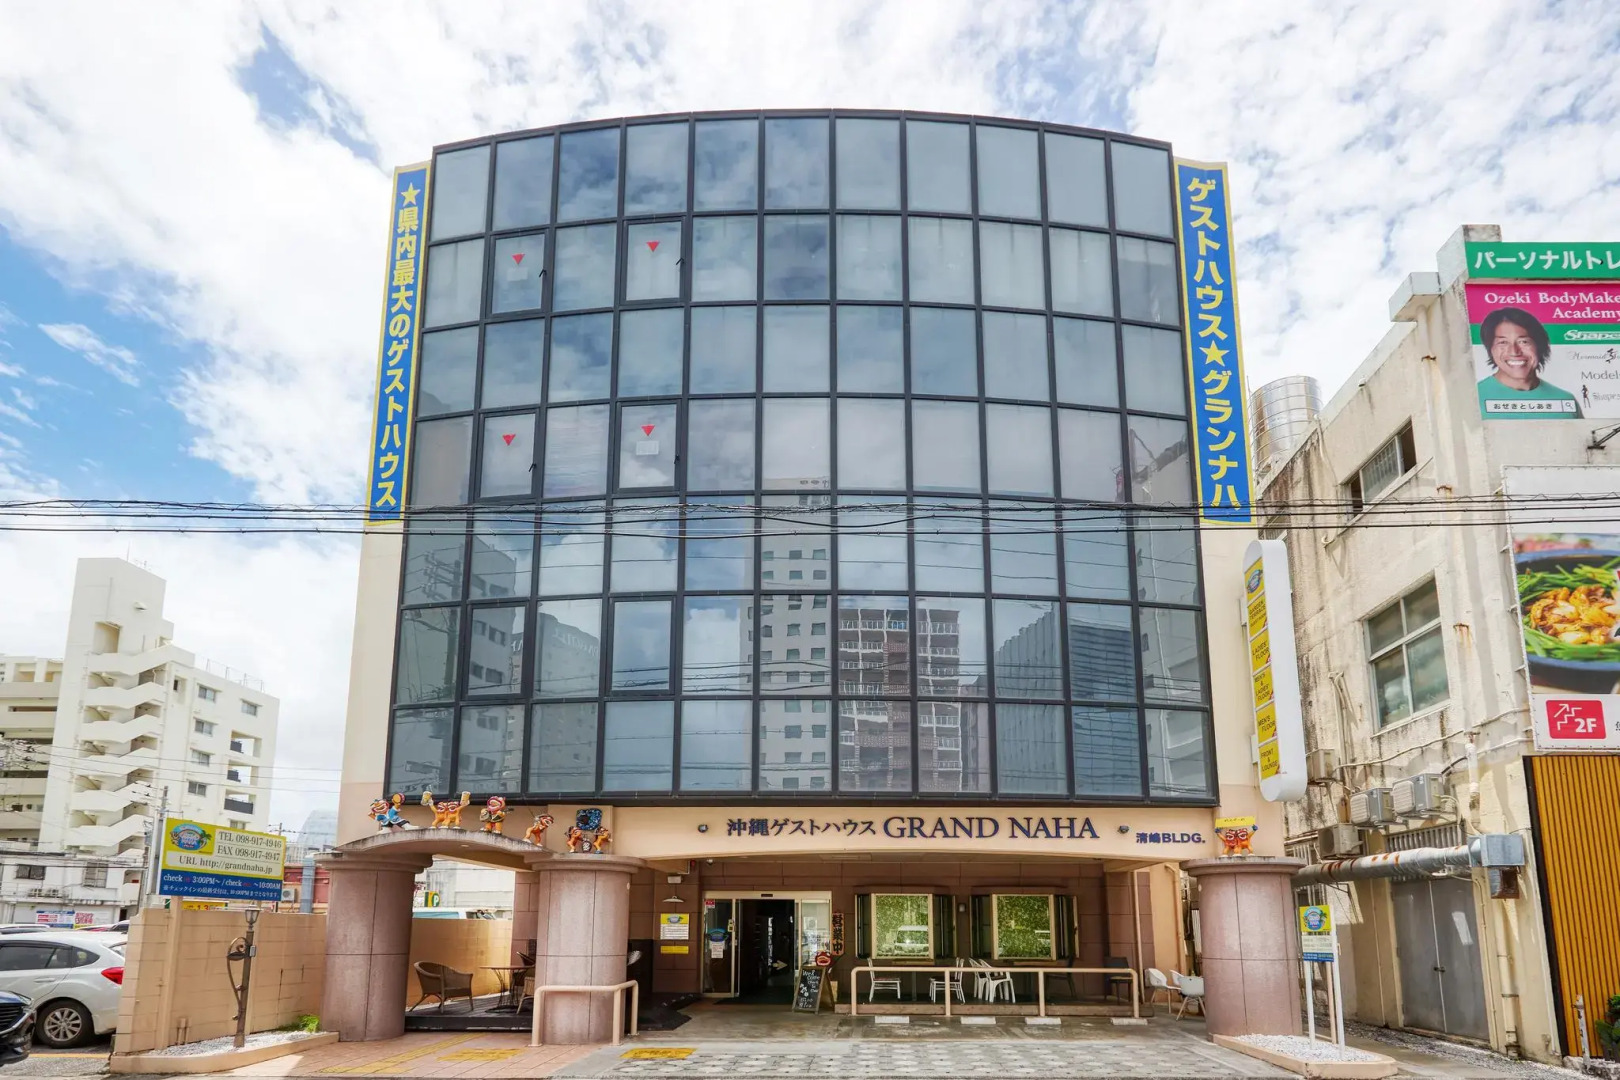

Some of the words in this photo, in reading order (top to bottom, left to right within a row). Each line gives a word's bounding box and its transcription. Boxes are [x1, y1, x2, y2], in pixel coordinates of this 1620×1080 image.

[1485, 292, 1531, 304] Ozeki
[376, 206, 419, 508] 県内最大のゲストハウス
[1581, 370, 1620, 380] Model
[1493, 402, 1553, 410] おぜきとしあき
[1255, 647, 1270, 661] FLOOR
[1257, 690, 1270, 702] FLOOR
[1262, 720, 1276, 733] FLOOR
[1574, 717, 1597, 733] 2F
[1261, 748, 1274, 758] FRONT
[1262, 760, 1278, 772] LOUNGE
[883, 816, 1000, 839] GRAND
[1008, 816, 1100, 839] NAHA
[218, 831, 234, 841] TEL
[217, 845, 233, 856] FAX
[179, 855, 198, 865] URL
[200, 857, 273, 874] http://grandnaha.jp
[163, 873, 183, 883] check
[225, 878, 242, 887] check
